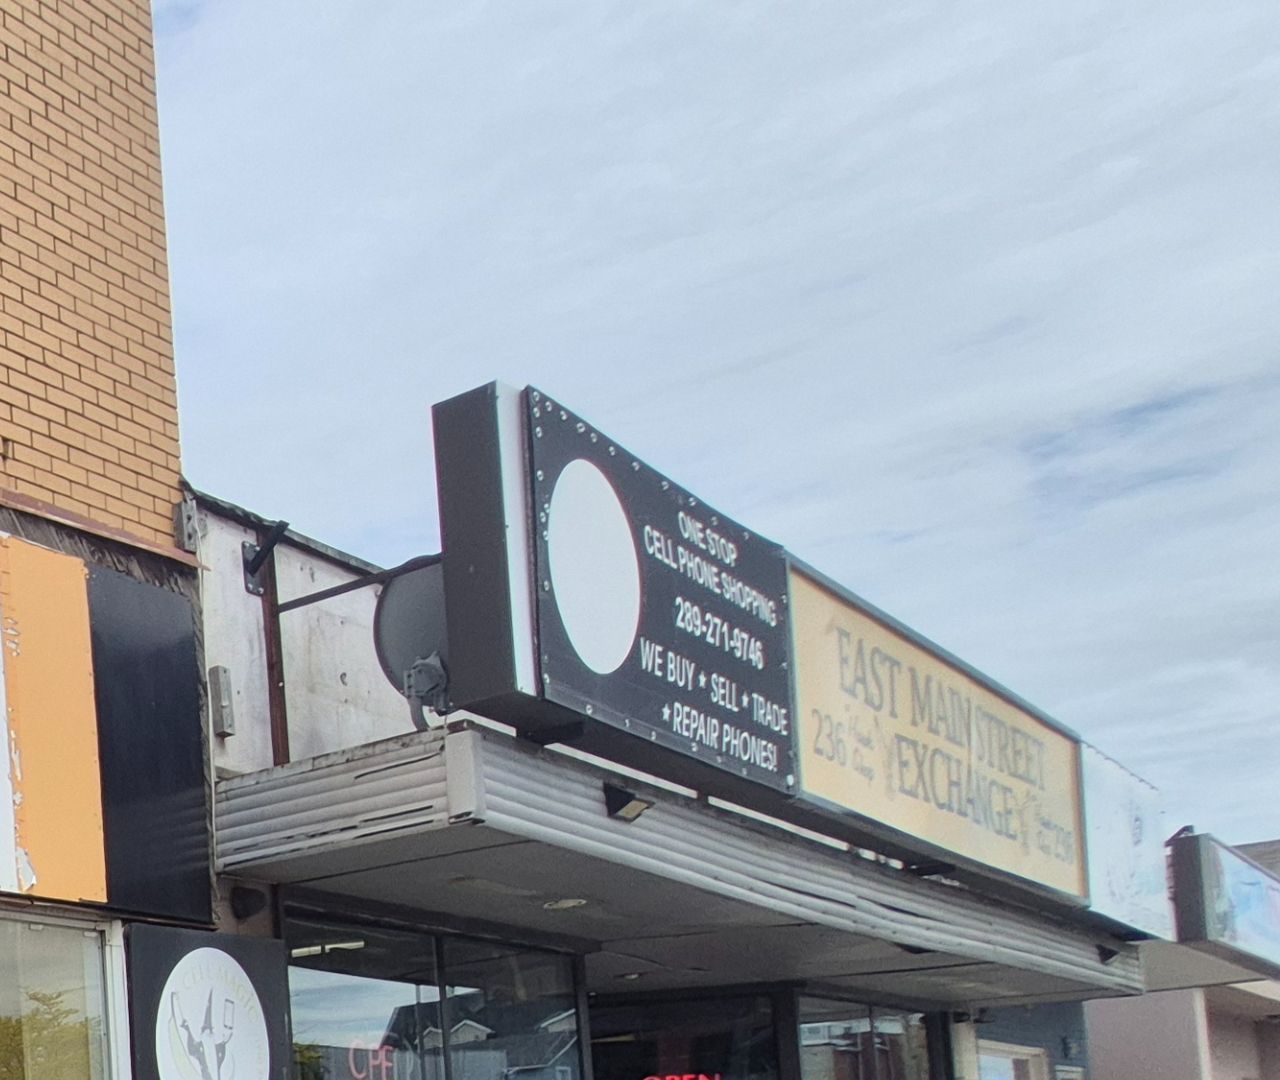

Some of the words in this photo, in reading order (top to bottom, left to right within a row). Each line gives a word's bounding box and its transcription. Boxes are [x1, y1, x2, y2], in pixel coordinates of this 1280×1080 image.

[643, 524, 678, 569] CELL
[677, 545, 722, 594] PHONE
[721, 572, 777, 627] SHOPPING
[677, 510, 707, 550] ONE
[705, 528, 738, 567] STOP
[675, 596, 764, 670] 289-271-9746
[640, 636, 664, 677] WE
[666, 651, 696, 691] BUY
[710, 672, 740, 712] SELL
[751, 692, 789, 736] TRADE
[836, 626, 902, 719] EAST
[973, 704, 1046, 791] STREET
[672, 701, 719, 750] REPAIR
[721, 724, 778, 772] PHONES!
[894, 732, 1019, 841] EXCHANGE
